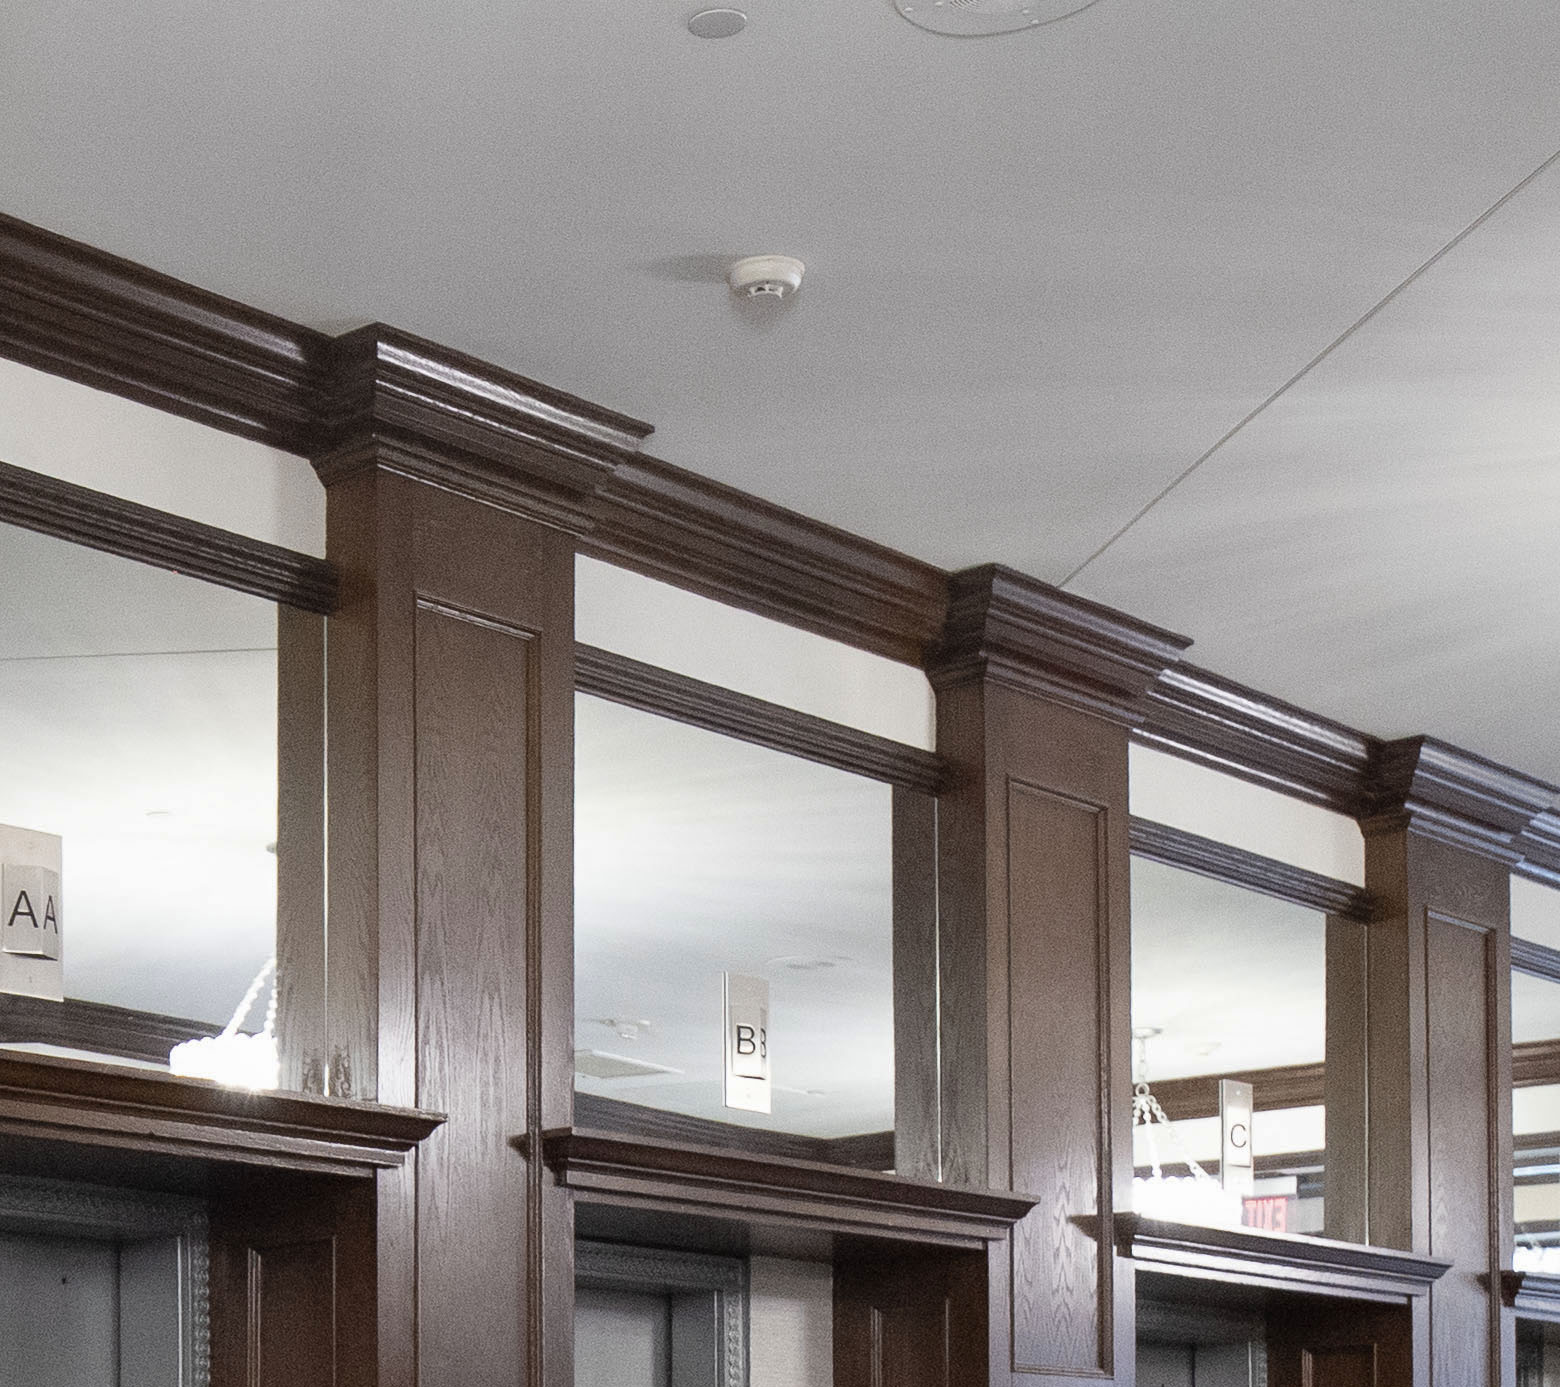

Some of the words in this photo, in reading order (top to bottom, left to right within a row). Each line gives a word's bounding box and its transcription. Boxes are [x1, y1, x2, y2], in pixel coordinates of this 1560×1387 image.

[8, 890, 39, 929] A
[43, 895, 58, 934] A
[736, 1025, 756, 1055] B
[1230, 1124, 1247, 1148] C
